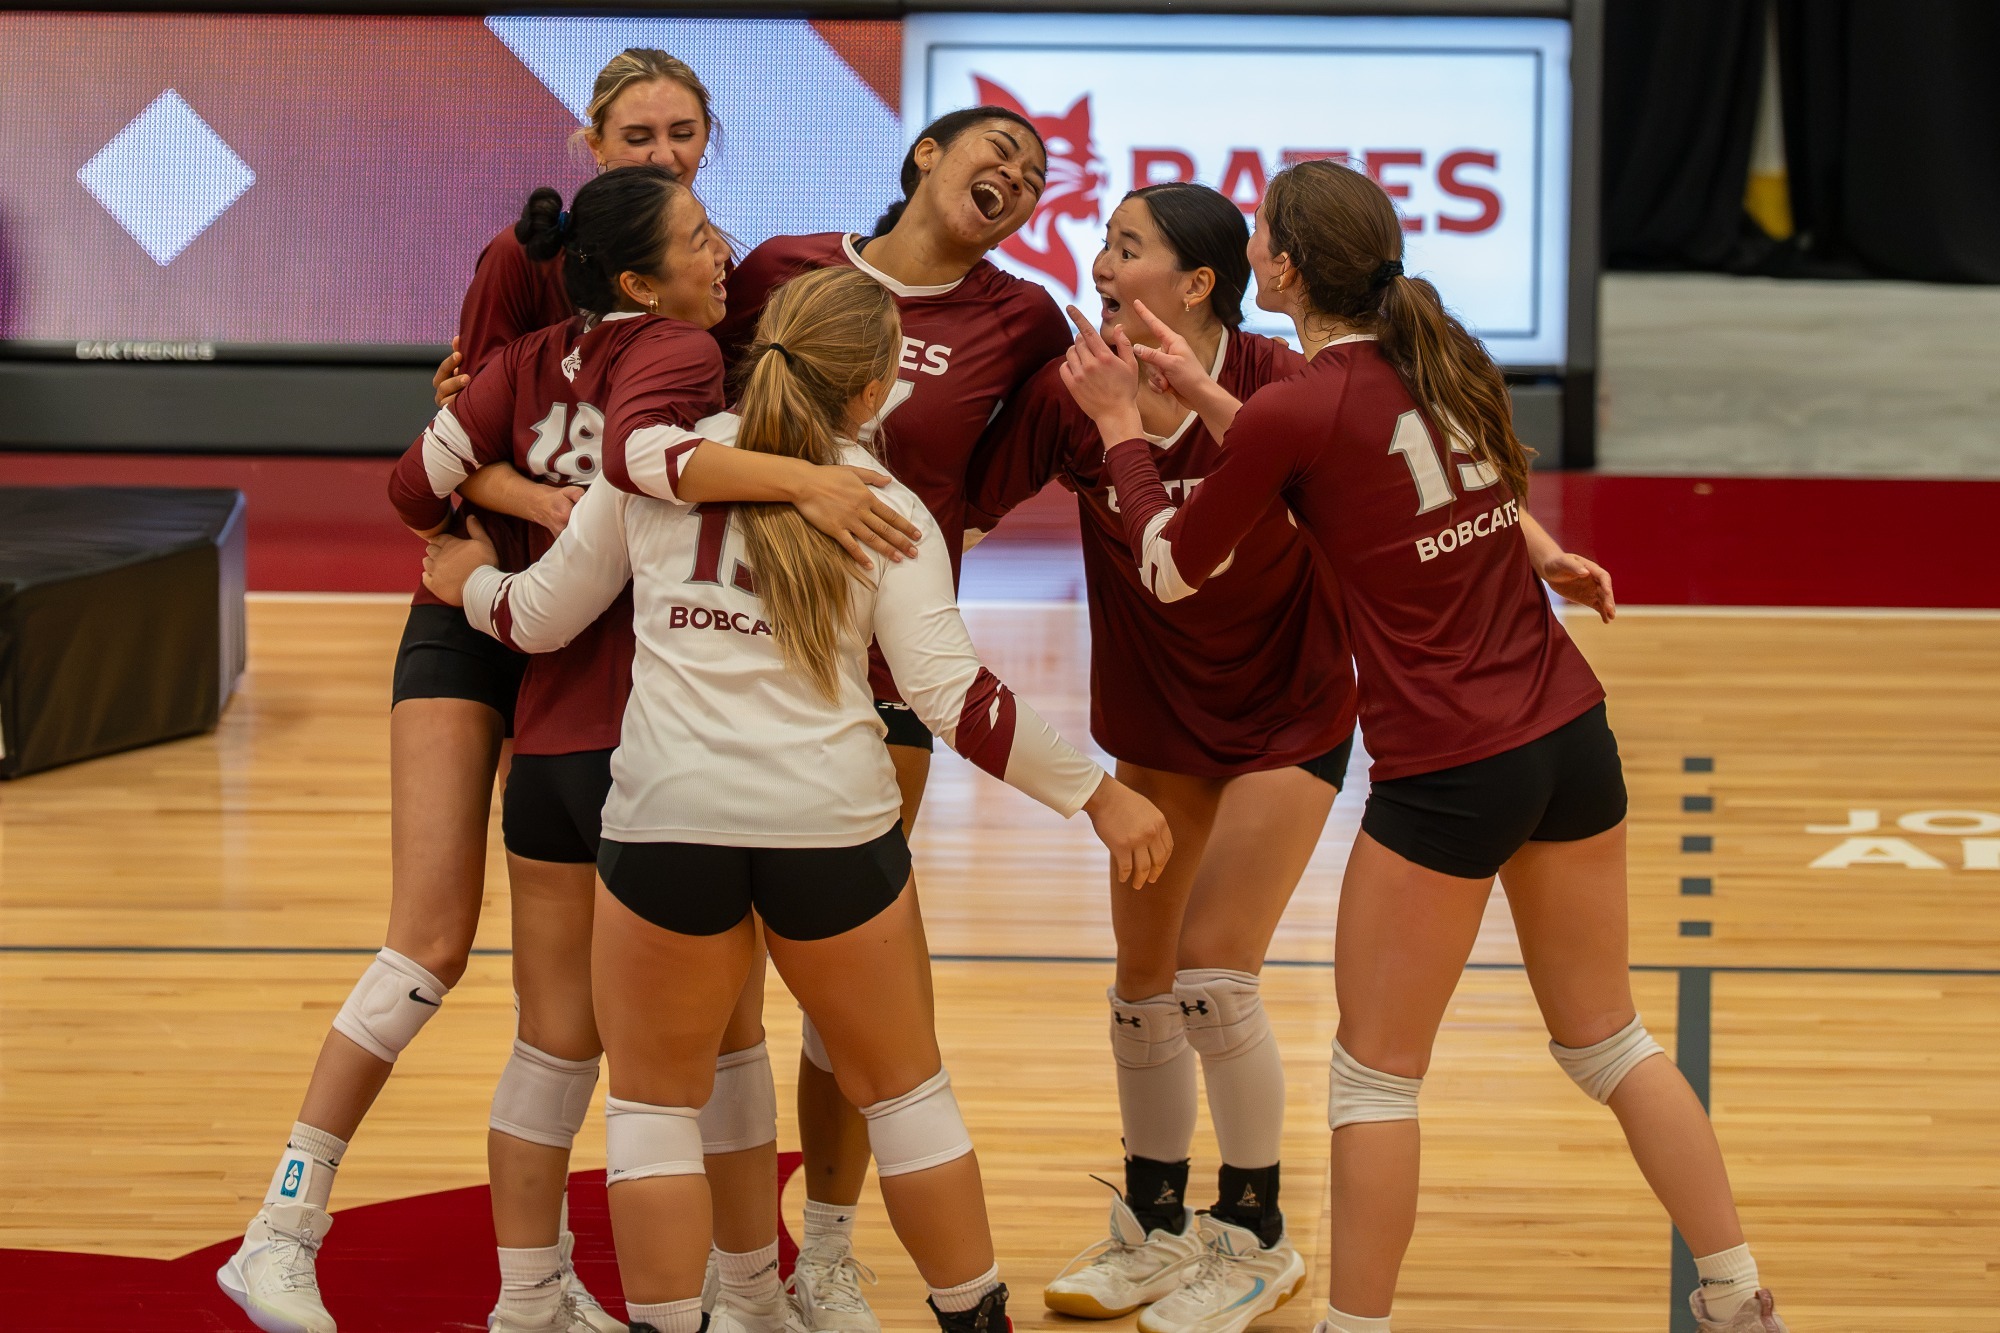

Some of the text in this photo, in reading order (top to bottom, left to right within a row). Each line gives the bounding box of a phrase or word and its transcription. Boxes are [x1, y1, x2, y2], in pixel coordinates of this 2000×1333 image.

[1132, 150, 1504, 233] AES
[527, 402, 605, 485] 18
[682, 502, 763, 598] 1
[1415, 499, 1519, 563] BOBCATS
[669, 606, 773, 636] BOBCA
